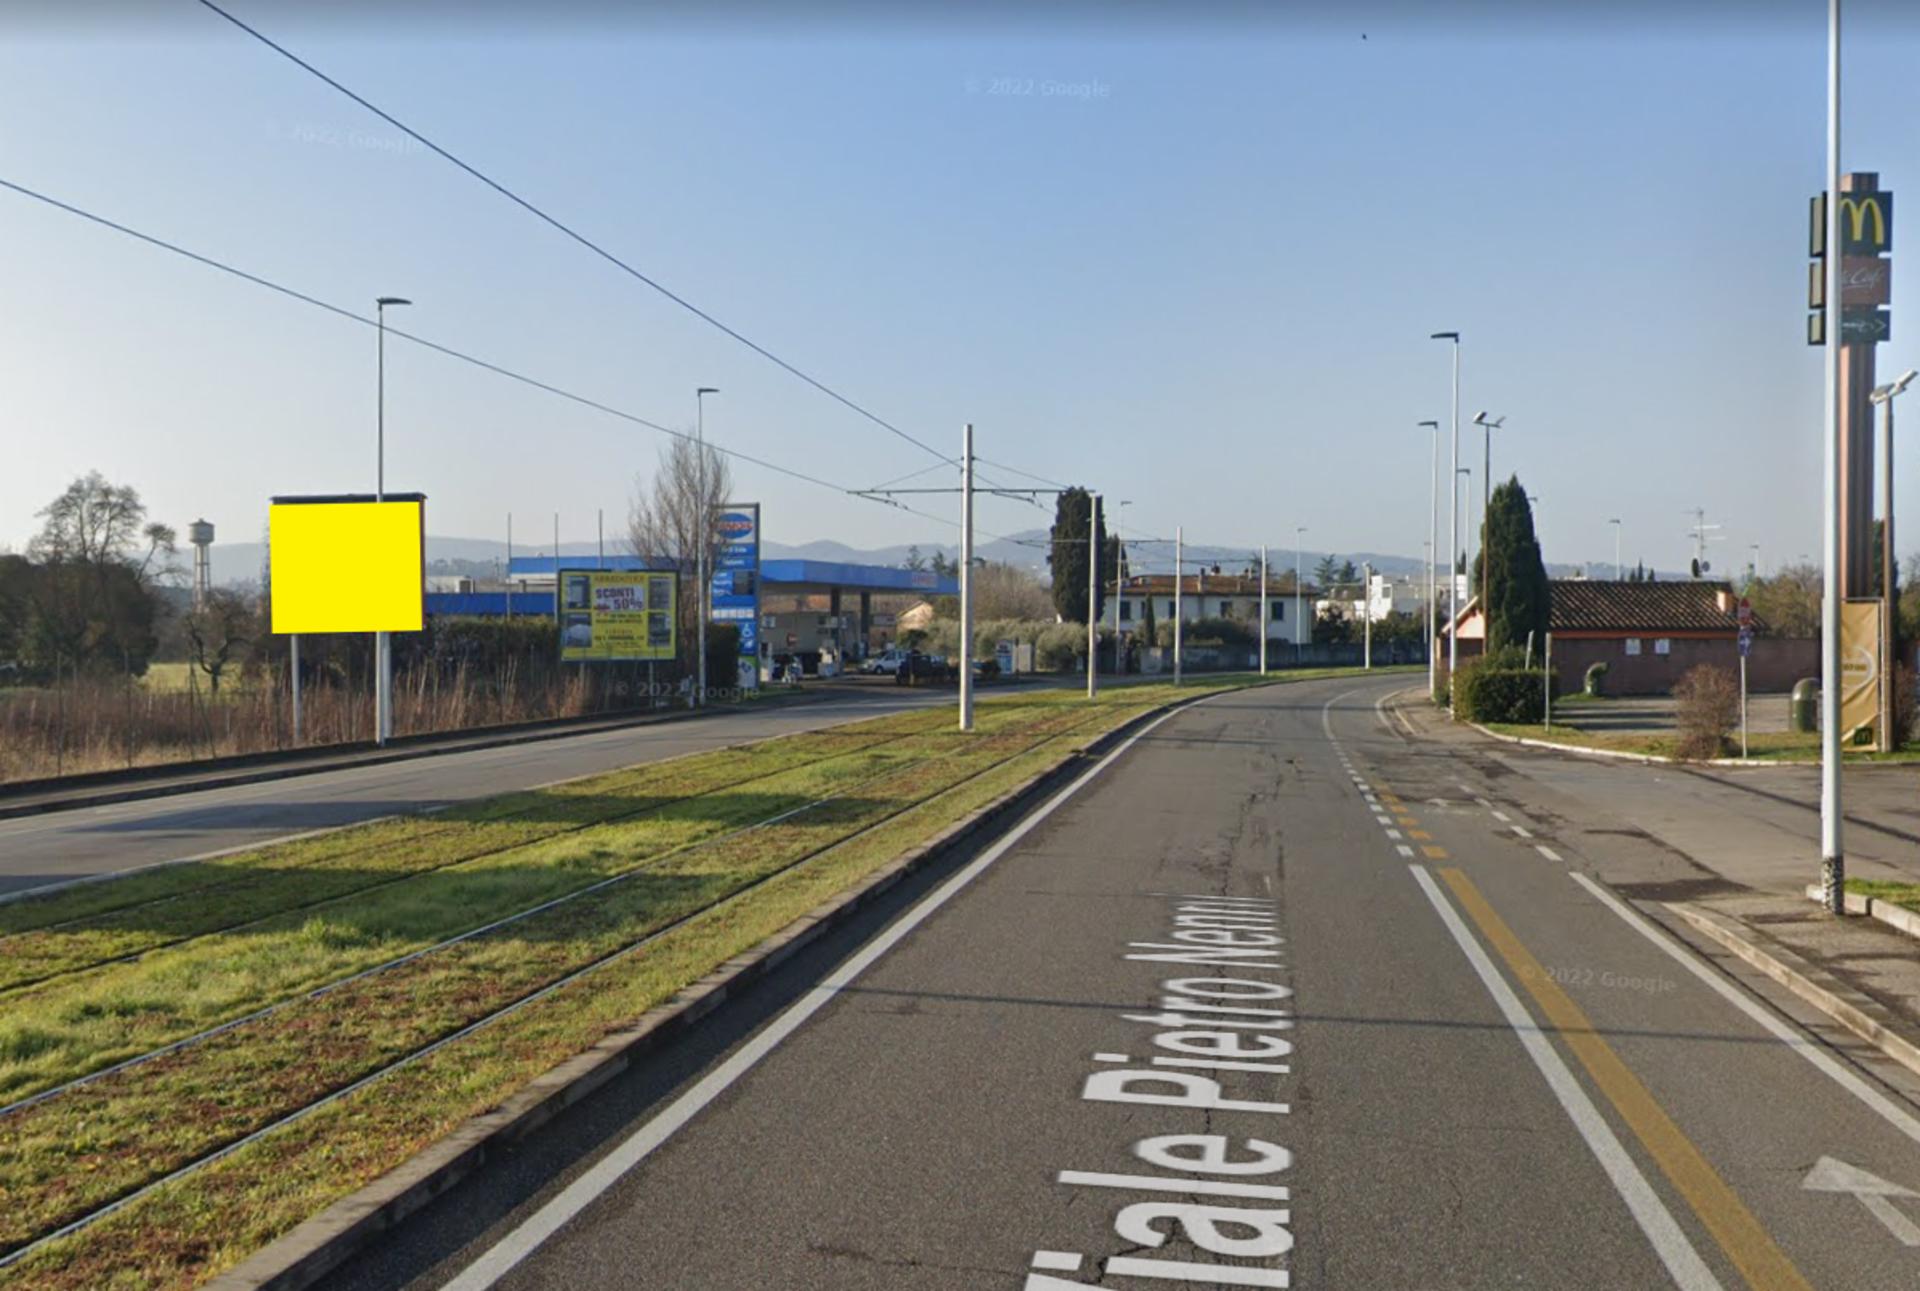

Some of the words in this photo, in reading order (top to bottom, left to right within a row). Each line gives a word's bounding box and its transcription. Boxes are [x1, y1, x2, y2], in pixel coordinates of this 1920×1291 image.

[595, 588, 635, 599] SCONTI
[1122, 892, 1288, 969] Nenni
[1082, 977, 1294, 1113] Pietro
